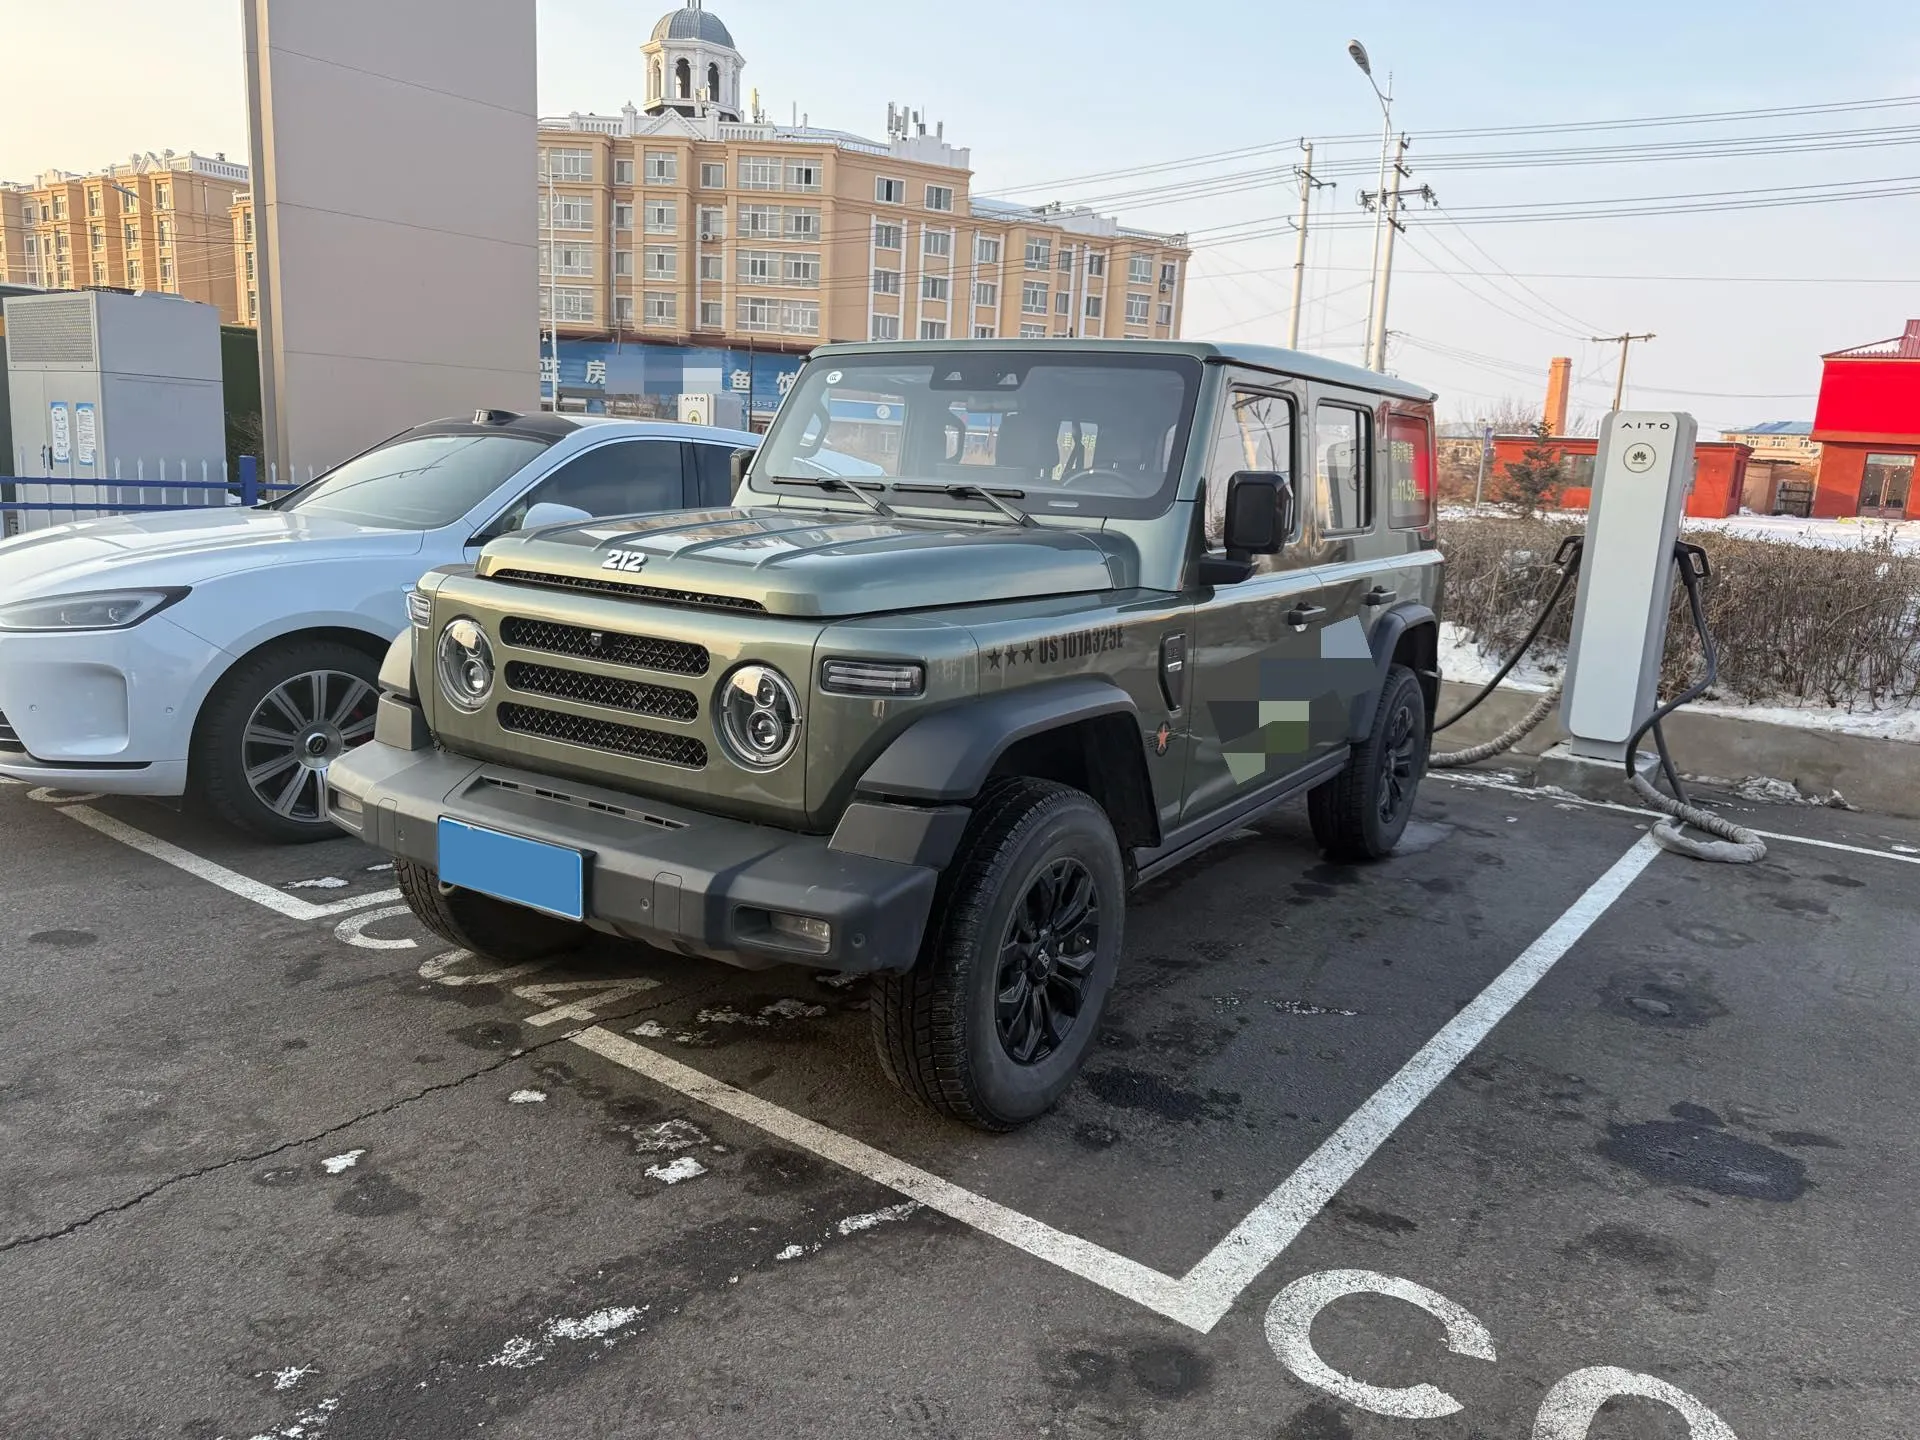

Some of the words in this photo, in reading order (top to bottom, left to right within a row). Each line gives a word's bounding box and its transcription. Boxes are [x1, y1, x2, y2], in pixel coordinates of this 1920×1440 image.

[1621, 422, 1670, 430] AITO
[602, 549, 647, 573] 212
[1039, 636, 1058, 665] US
